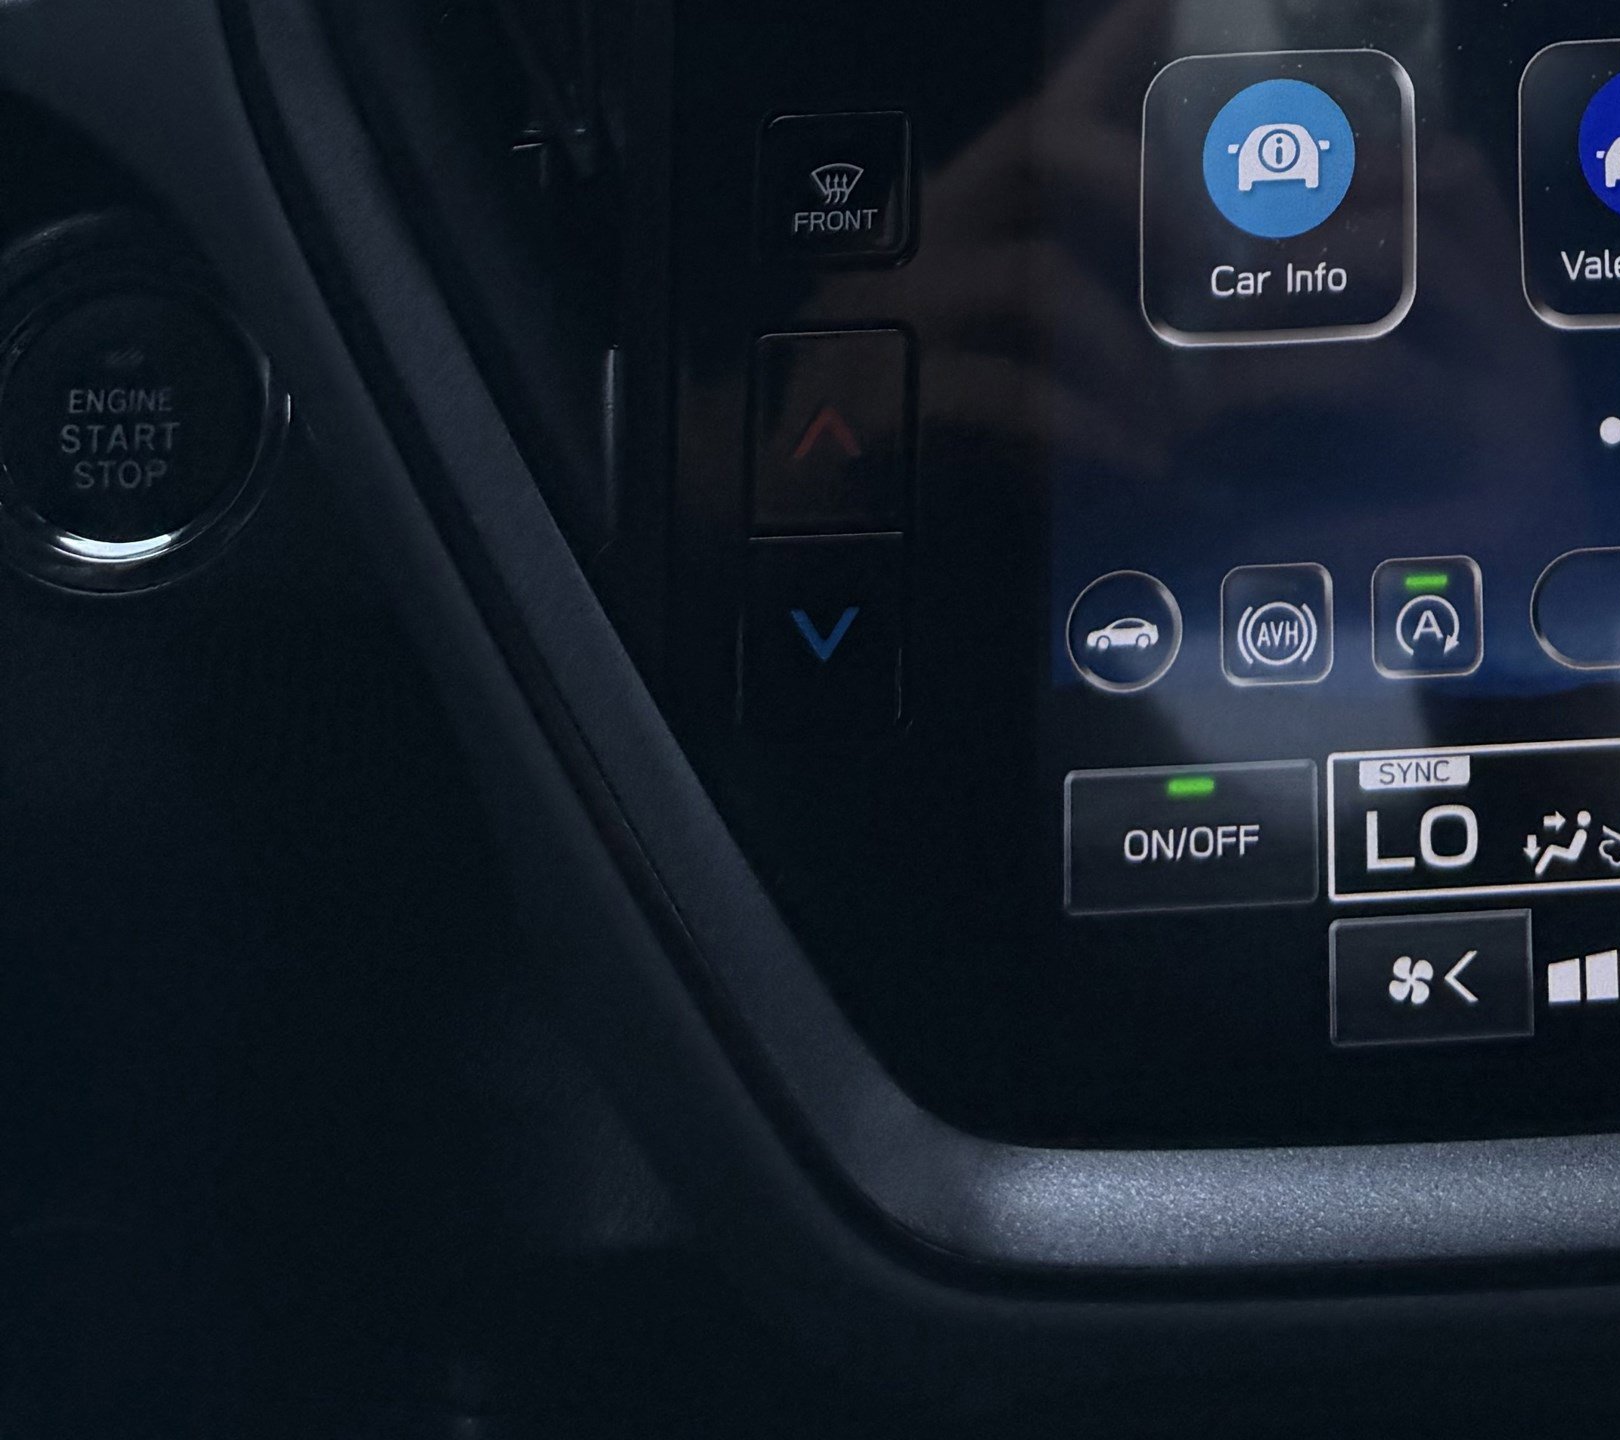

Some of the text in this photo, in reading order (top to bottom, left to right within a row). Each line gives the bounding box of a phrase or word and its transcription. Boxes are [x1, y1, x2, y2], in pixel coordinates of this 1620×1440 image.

[793, 208, 879, 233] FRONT
[1210, 261, 1347, 297] Car Info
[68, 388, 173, 414] ENGINE
[60, 422, 180, 454] START
[74, 459, 168, 489] STOP
[1375, 758, 1452, 787] SYNC
[1123, 824, 1260, 862] ON/OFF
[1365, 804, 1479, 872] LO
